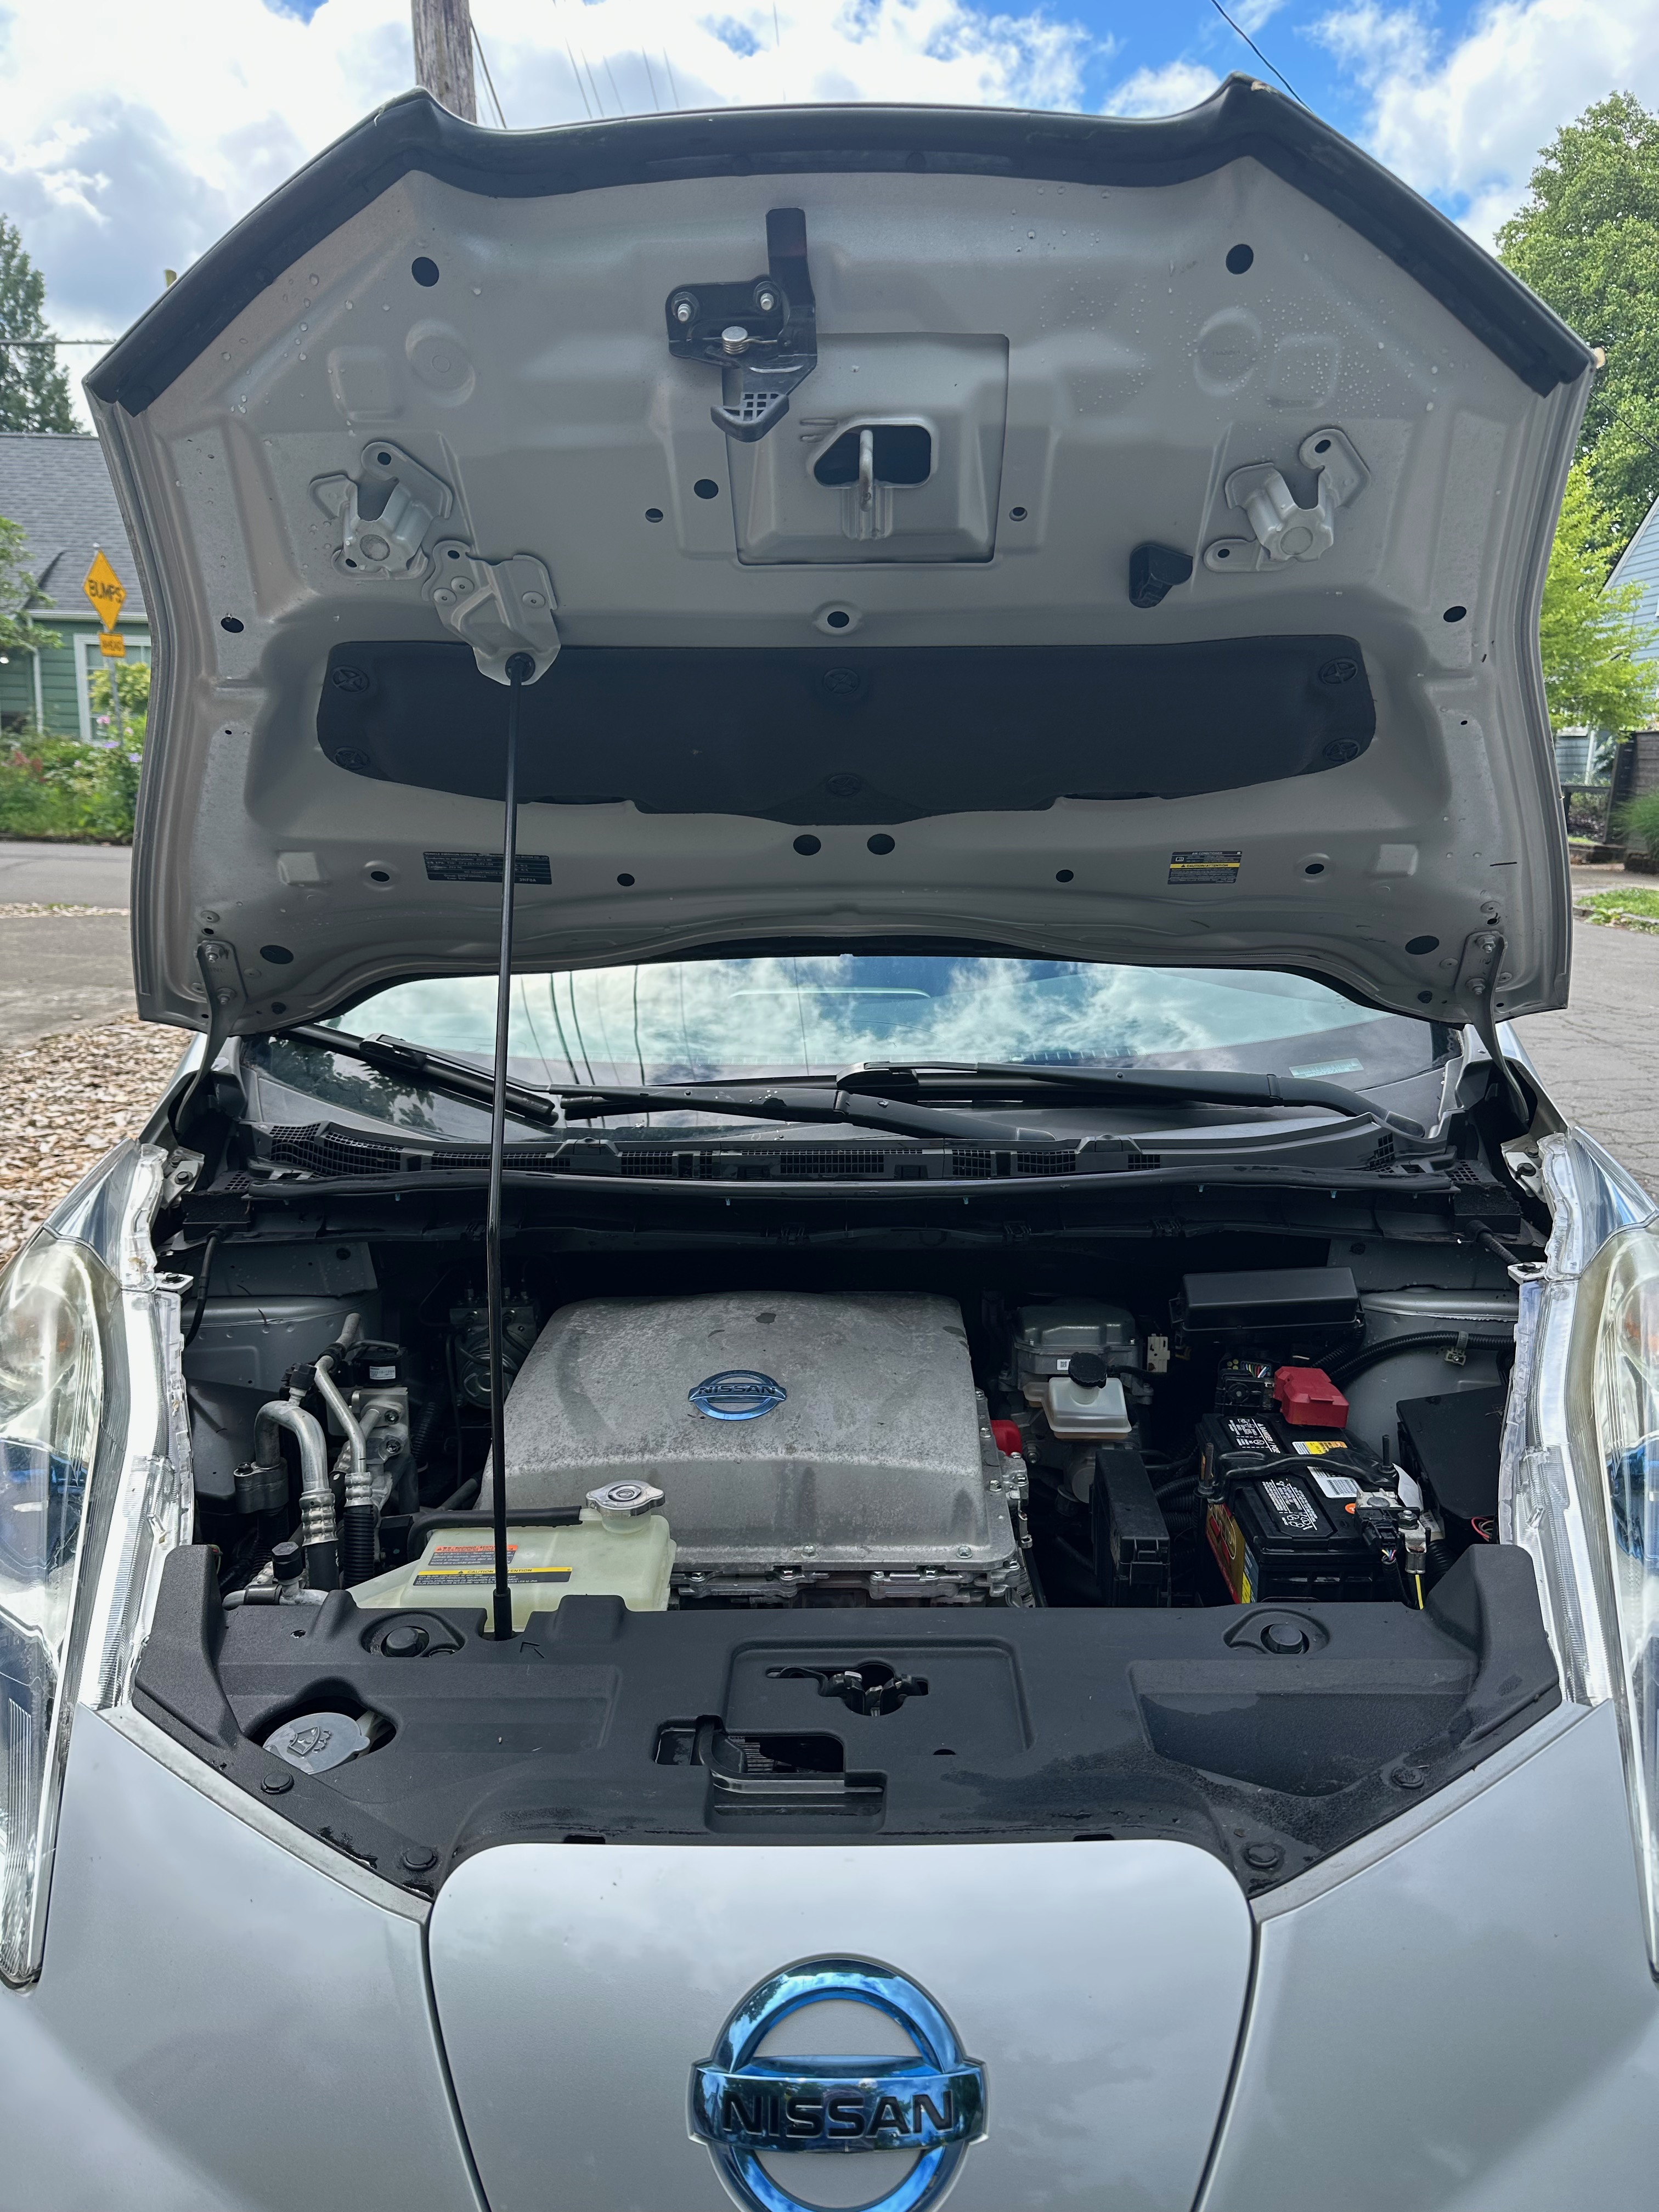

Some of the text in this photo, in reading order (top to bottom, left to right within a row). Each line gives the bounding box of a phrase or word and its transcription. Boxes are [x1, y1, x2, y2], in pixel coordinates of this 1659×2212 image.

[88, 579, 123, 603] BUMPS
[698, 1385, 777, 1395] NISSAN
[722, 2089, 955, 2140] NISSAN
